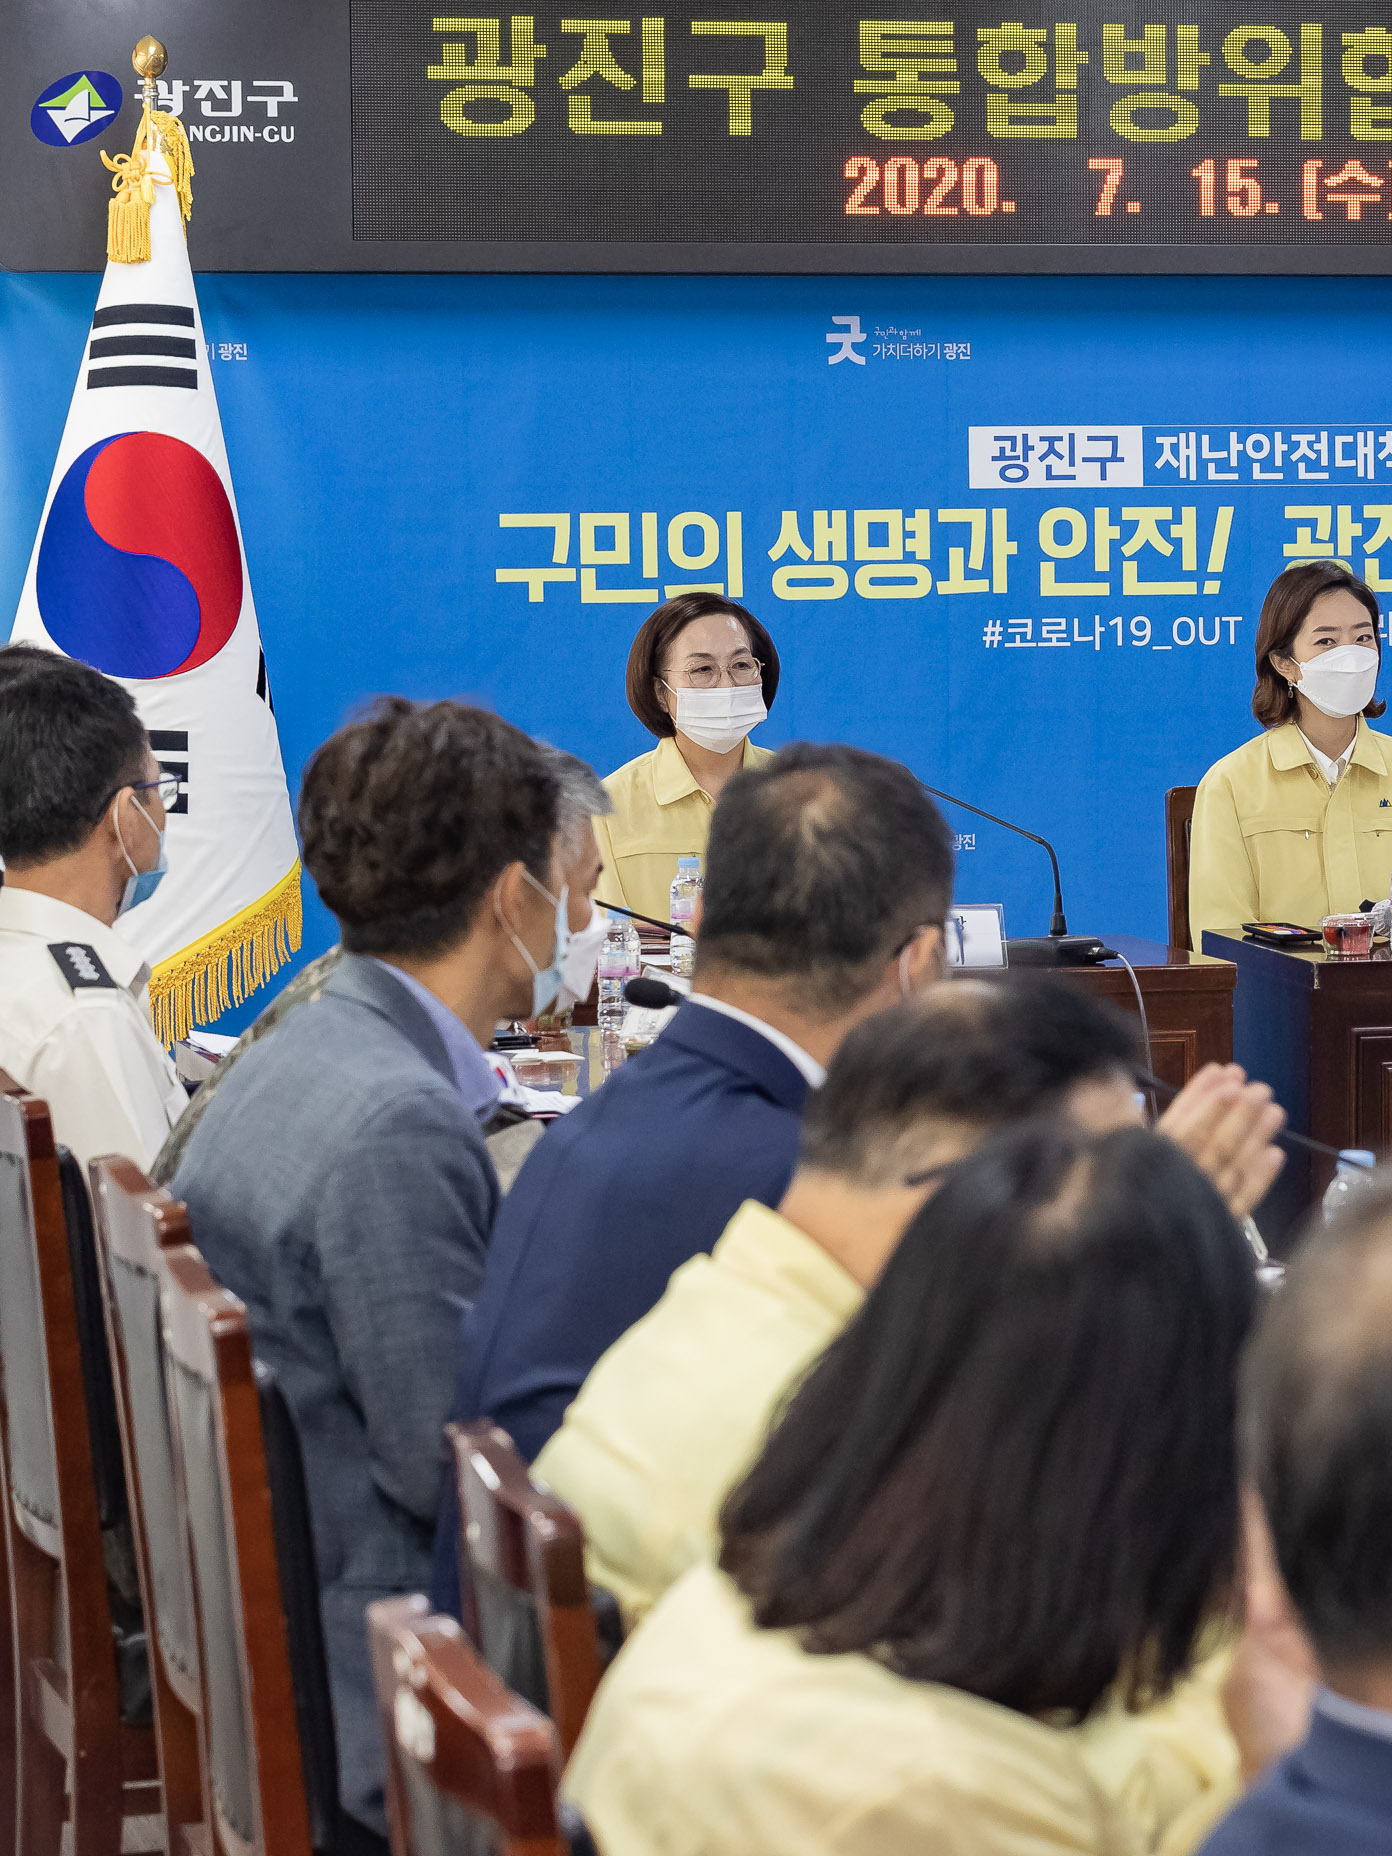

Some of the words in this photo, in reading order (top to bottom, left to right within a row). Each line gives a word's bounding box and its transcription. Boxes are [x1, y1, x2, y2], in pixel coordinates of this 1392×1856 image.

[426, 15, 794, 137] 광진구
[133, 78, 299, 118] 광진구
[188, 126, 295, 143] NGJIN-GU
[843, 155, 1016, 216] 2020.
[1088, 156, 1142, 216] 7.
[218, 342, 248, 361] 광진
[872, 342, 941, 360] 가치더하기
[943, 342, 971, 361] 광진
[991, 432, 1125, 483] 광진구
[495, 511, 743, 603] 구민의
[768, 508, 1017, 601] 생명과
[1038, 506, 1234, 596] 안전!
[982, 614, 1243, 651] #코로나19_OUT
